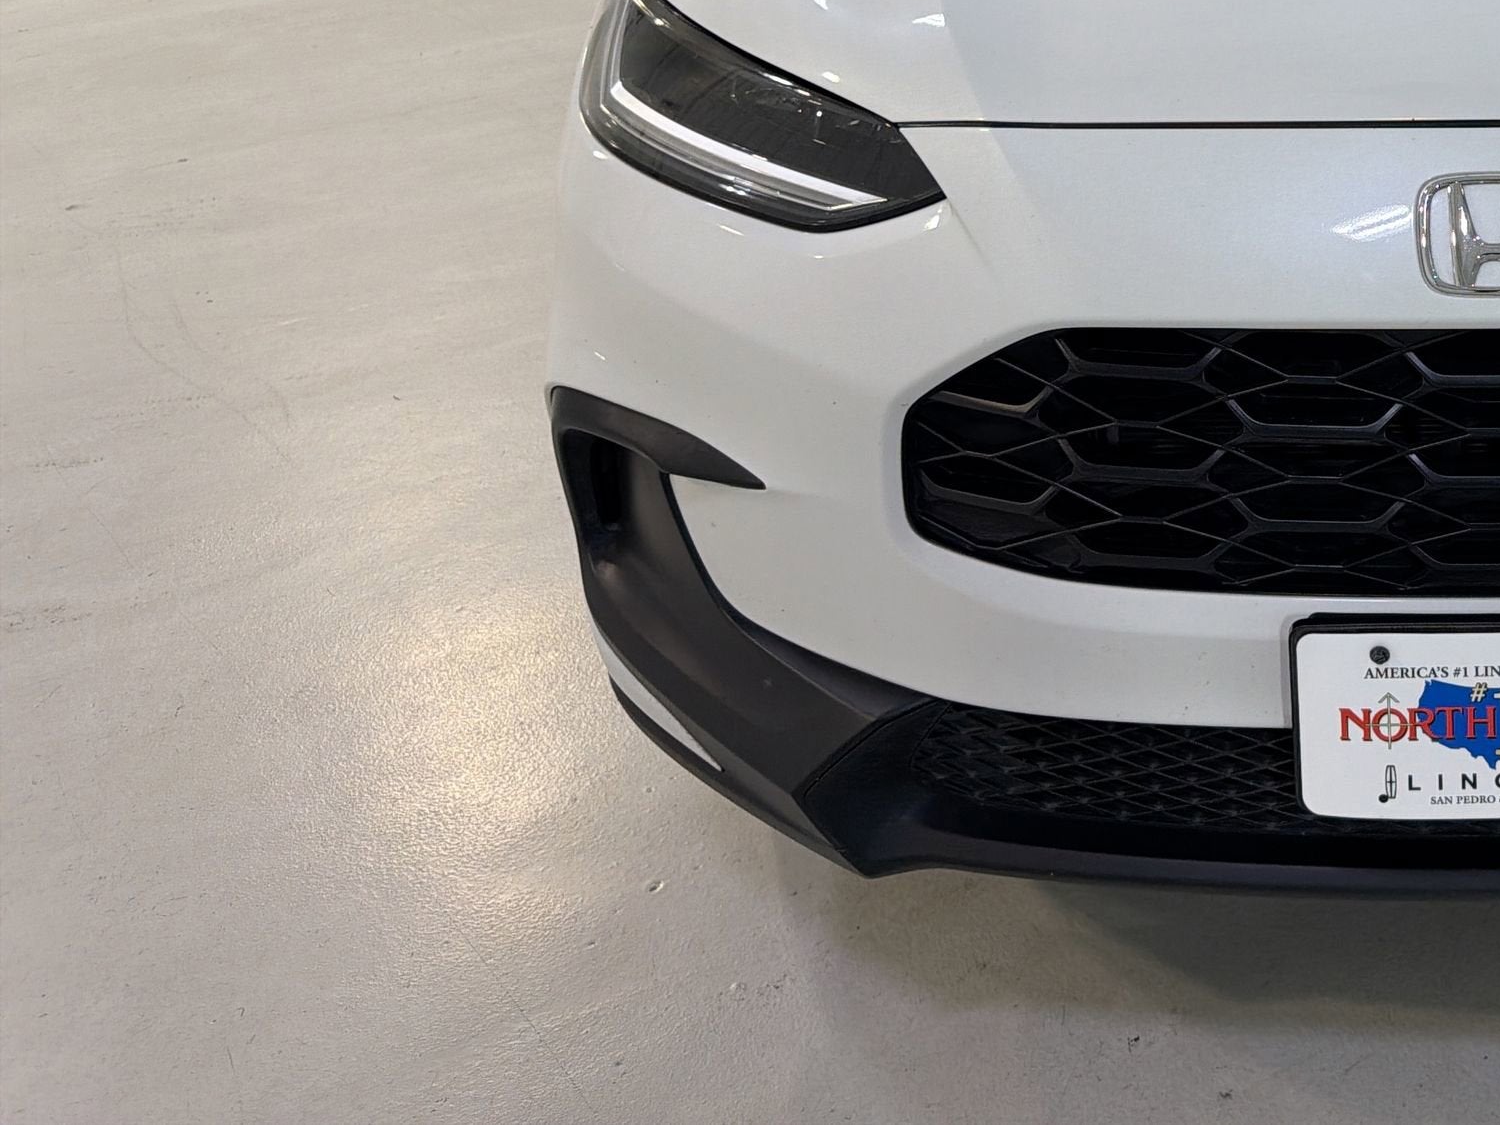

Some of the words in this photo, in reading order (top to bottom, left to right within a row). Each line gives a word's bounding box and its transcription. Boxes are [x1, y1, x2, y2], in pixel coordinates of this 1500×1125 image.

[1364, 666, 1449, 679] AMERICA'S
[1453, 666, 1470, 678] #1
[1338, 705, 1497, 743] NORTH
[1430, 795, 1453, 806] SAN
[1456, 794, 1497, 805] PEDRO
